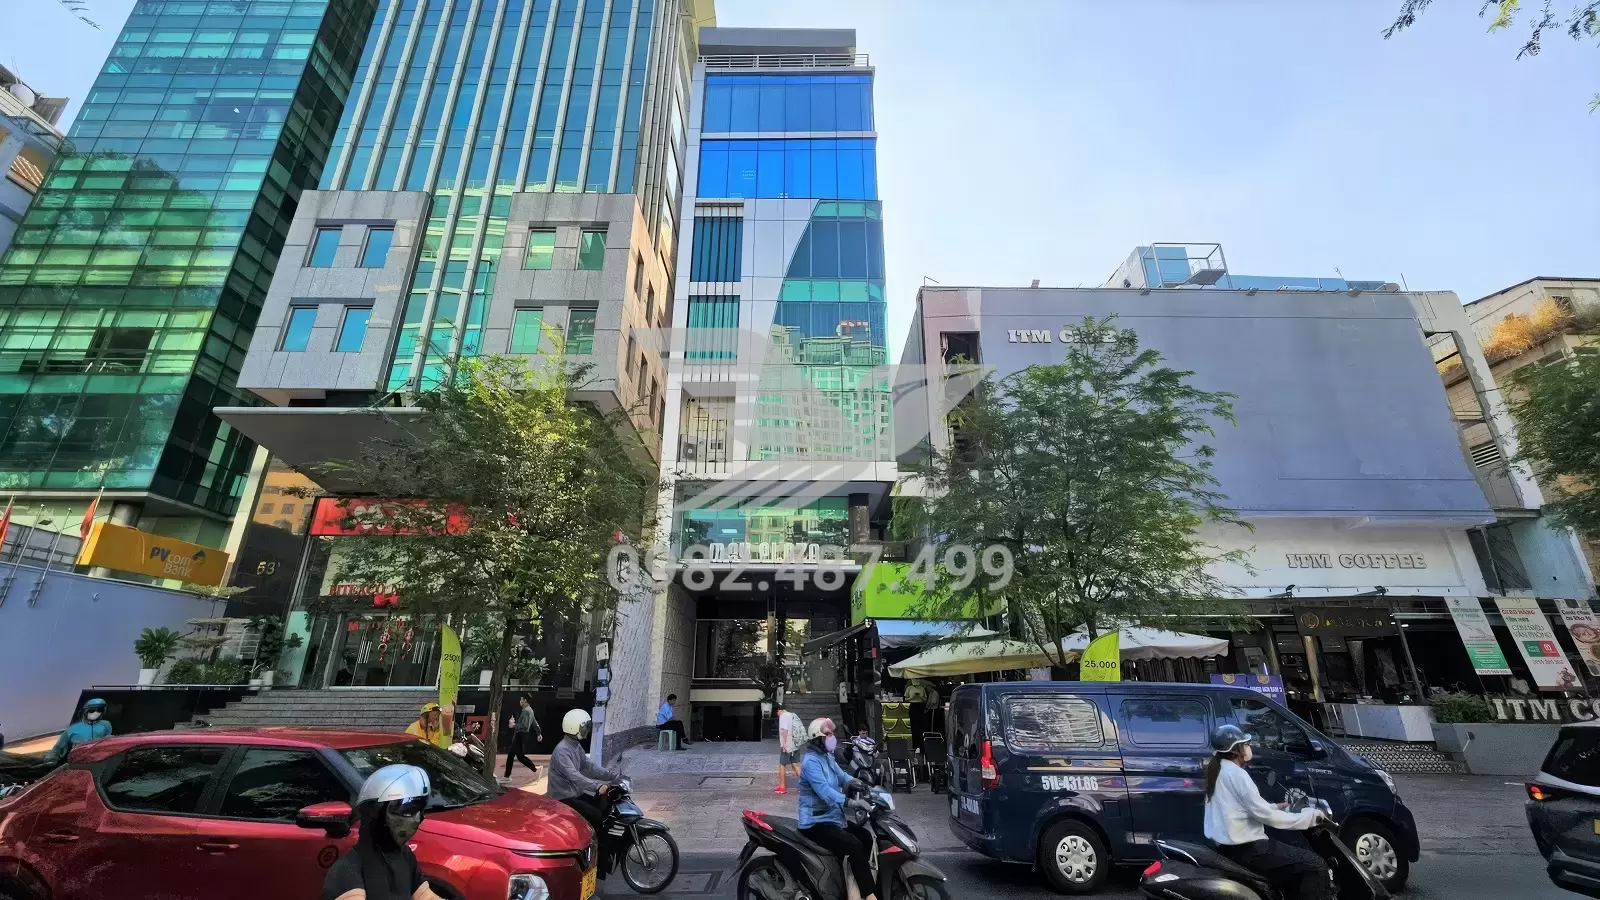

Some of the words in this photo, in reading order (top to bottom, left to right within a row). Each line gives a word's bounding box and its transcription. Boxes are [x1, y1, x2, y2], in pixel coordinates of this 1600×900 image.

[1007, 329, 1052, 344] ITM
[1286, 553, 1333, 569] ITM
[1339, 553, 1427, 569] COFFEE
[163, 563, 192, 578] Bank
[1084, 660, 1117, 669] 25.000
[1492, 698, 1561, 720] ITM
